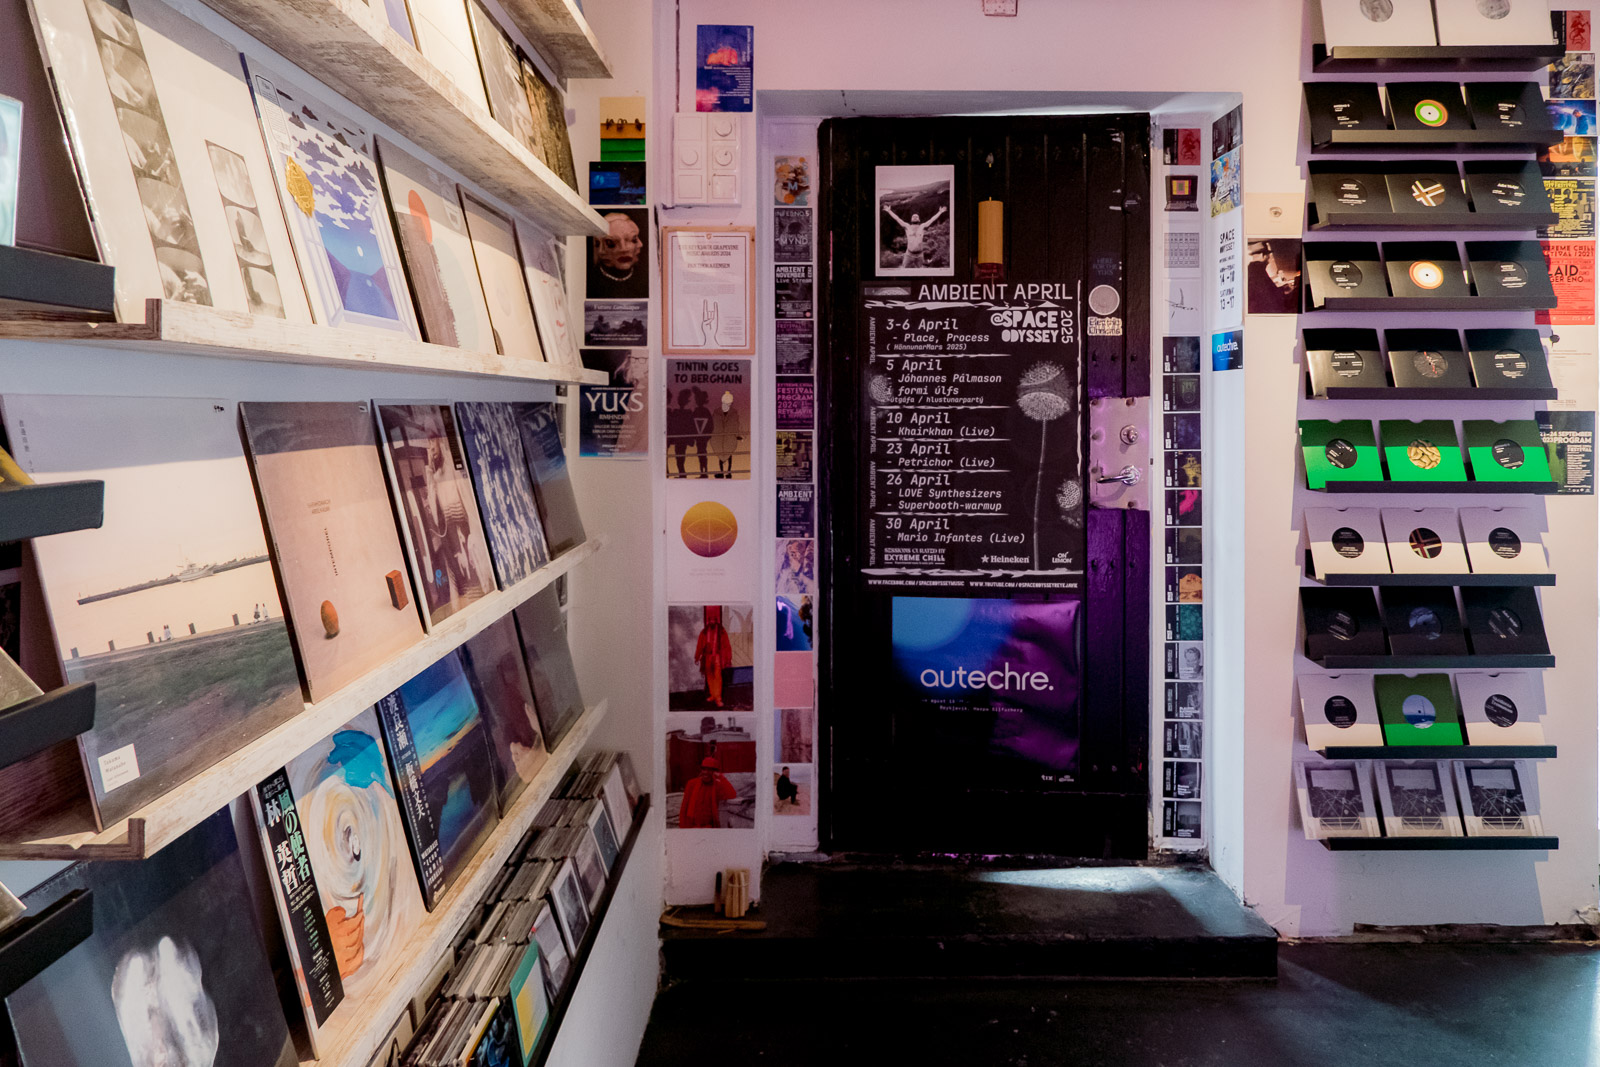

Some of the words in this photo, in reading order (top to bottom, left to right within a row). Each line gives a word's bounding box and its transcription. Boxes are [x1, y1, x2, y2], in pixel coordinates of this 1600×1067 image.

[1220, 229, 1234, 244] SPACE
[1548, 265, 1578, 276] AID
[918, 284, 1008, 300] AMBIENT
[1014, 284, 1073, 300] APRIL
[886, 319, 910, 330] 3-6
[918, 319, 958, 331] April
[1061, 310, 1073, 343] 2025
[904, 334, 939, 344] Place,
[947, 334, 989, 342] Process
[1001, 330, 1059, 343] ODYSSEY
[676, 362, 708, 371] TINTIN
[712, 362, 739, 371] GOES
[887, 360, 894, 370] 5
[902, 360, 942, 372] April
[674, 374, 688, 383] TO
[691, 374, 742, 384] BERGHAIN
[898, 374, 947, 383] Jóhannes
[953, 374, 1002, 383] Pálmason
[898, 386, 929, 396] formi
[934, 386, 959, 396] úlfs
[585, 392, 644, 412] YUKS
[887, 413, 902, 424] 10
[910, 412, 950, 425] April
[898, 427, 952, 436] Khairkhan
[960, 427, 995, 437] (Live)
[887, 444, 902, 454] 23
[910, 443, 950, 456] April
[898, 458, 953, 467] Petrichor
[960, 458, 995, 467] (Live)
[887, 474, 902, 485] 26
[910, 474, 950, 486] April
[898, 489, 922, 497] LOVE
[928, 489, 1002, 499] Synthesizers
[898, 501, 1002, 511] Superbooth-warmup
[886, 518, 902, 529] 30
[910, 518, 950, 531] April
[898, 533, 928, 542] Mario
[934, 533, 982, 542] Infantes
[989, 533, 1025, 543] (Live)
[920, 662, 1054, 690] autechre.
[278, 788, 311, 882] 風の使者
